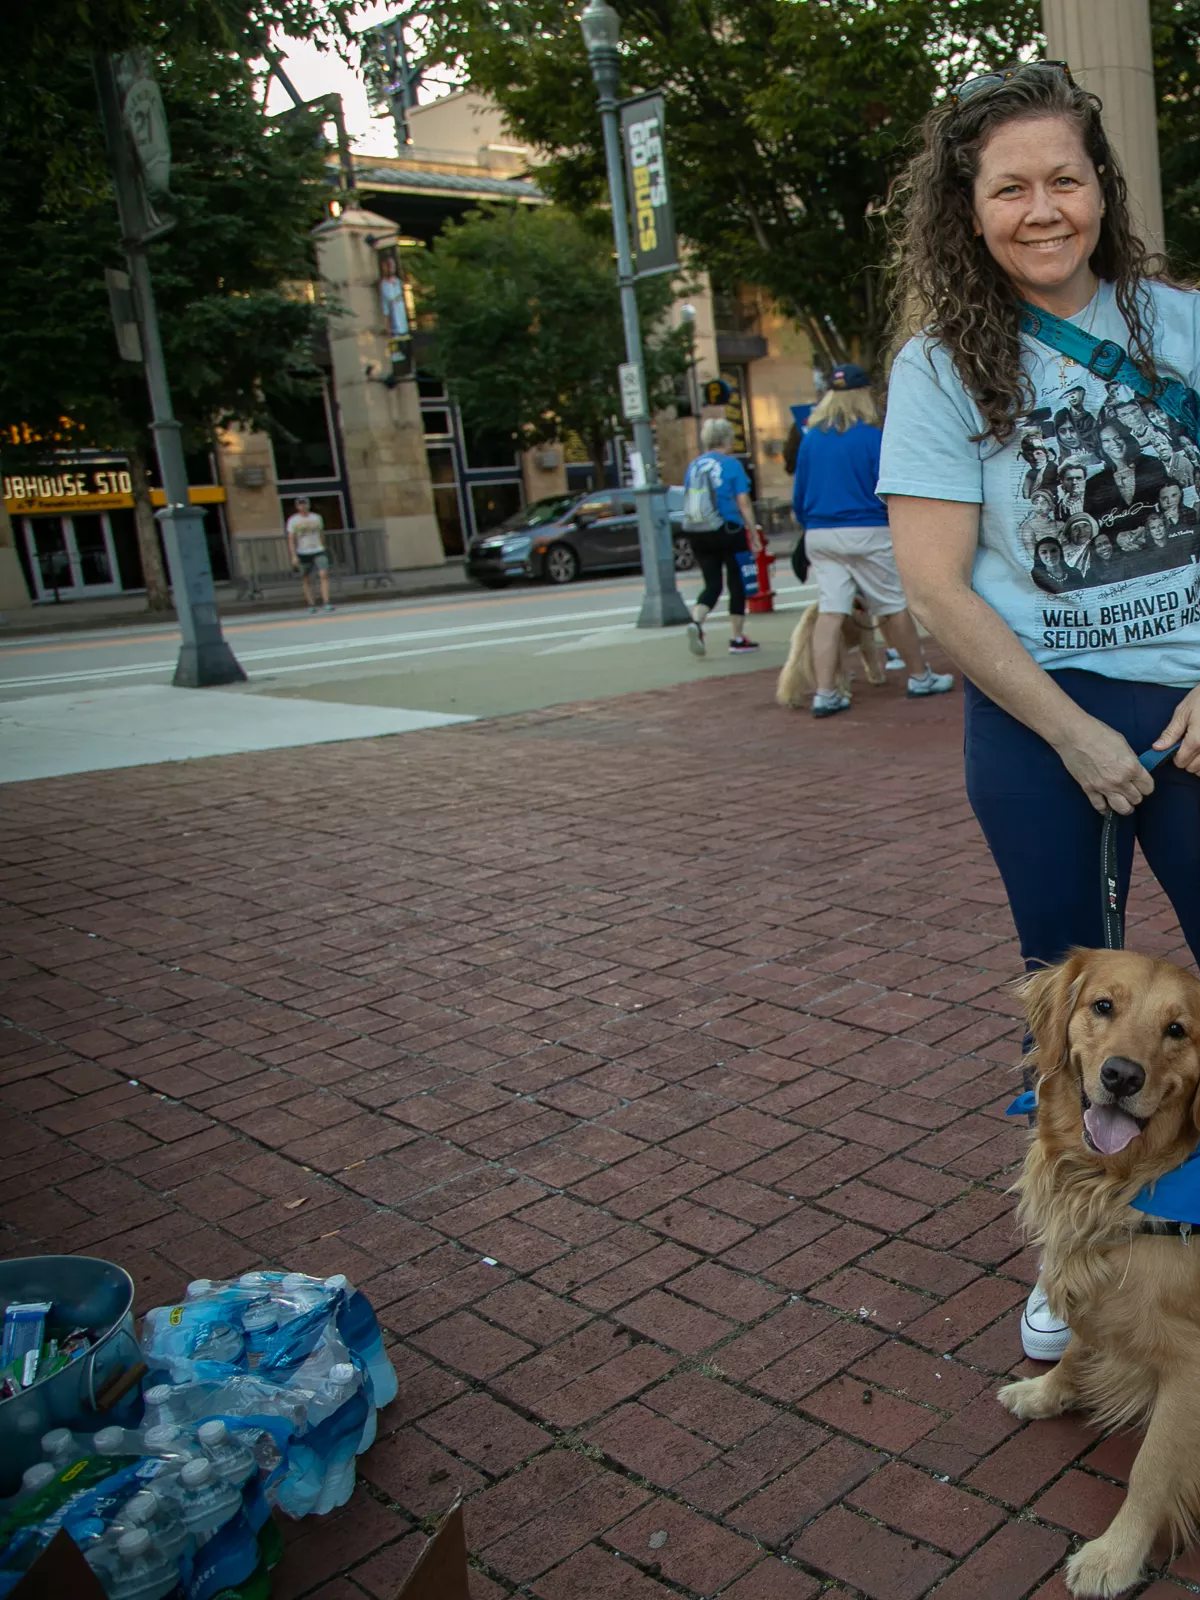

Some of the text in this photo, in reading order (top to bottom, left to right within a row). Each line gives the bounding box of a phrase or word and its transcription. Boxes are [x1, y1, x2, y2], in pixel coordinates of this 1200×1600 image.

[643, 117, 668, 208] LET'S
[94, 470, 133, 495] STO
[1042, 609, 1093, 628] WELL
[1100, 590, 1179, 626] BEHAVED
[1043, 627, 1118, 649] SELDOM
[1123, 614, 1176, 643] MAKE
